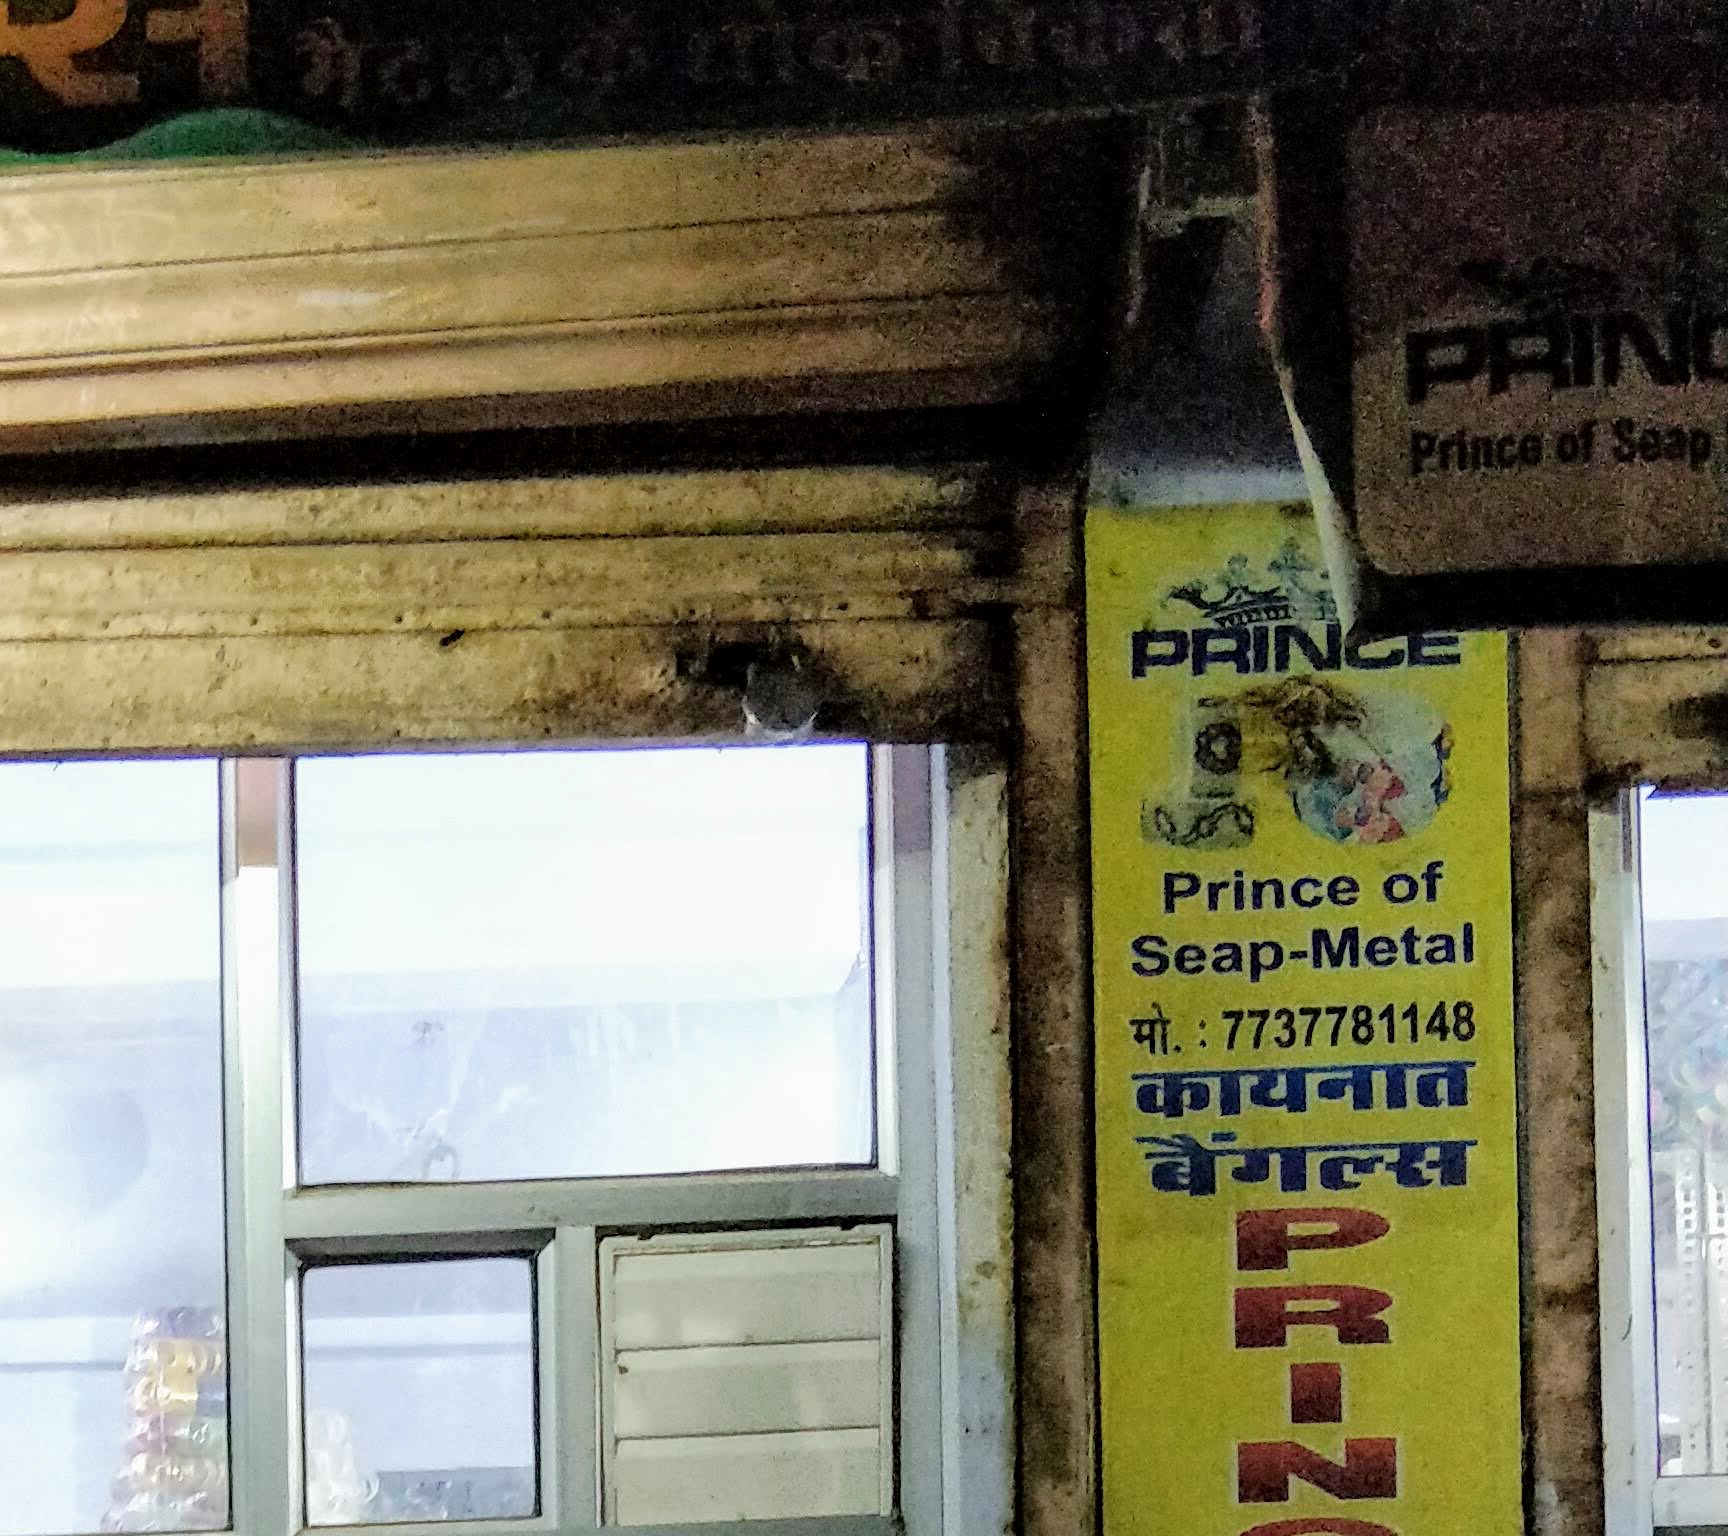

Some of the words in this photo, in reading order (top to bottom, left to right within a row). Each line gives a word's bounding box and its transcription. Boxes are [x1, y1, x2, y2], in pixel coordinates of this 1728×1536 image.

[1410, 427, 1544, 476] Prince
[1557, 420, 1596, 464] of
[1163, 871, 1360, 914] Prince
[1383, 861, 1444, 906] of
[1132, 921, 1475, 982] Seap-Metal
[1222, 1001, 1476, 1051] 7737781148
[1131, 1060, 1477, 1119] कायनात
[1133, 1131, 1478, 1196] बैंगल्स
